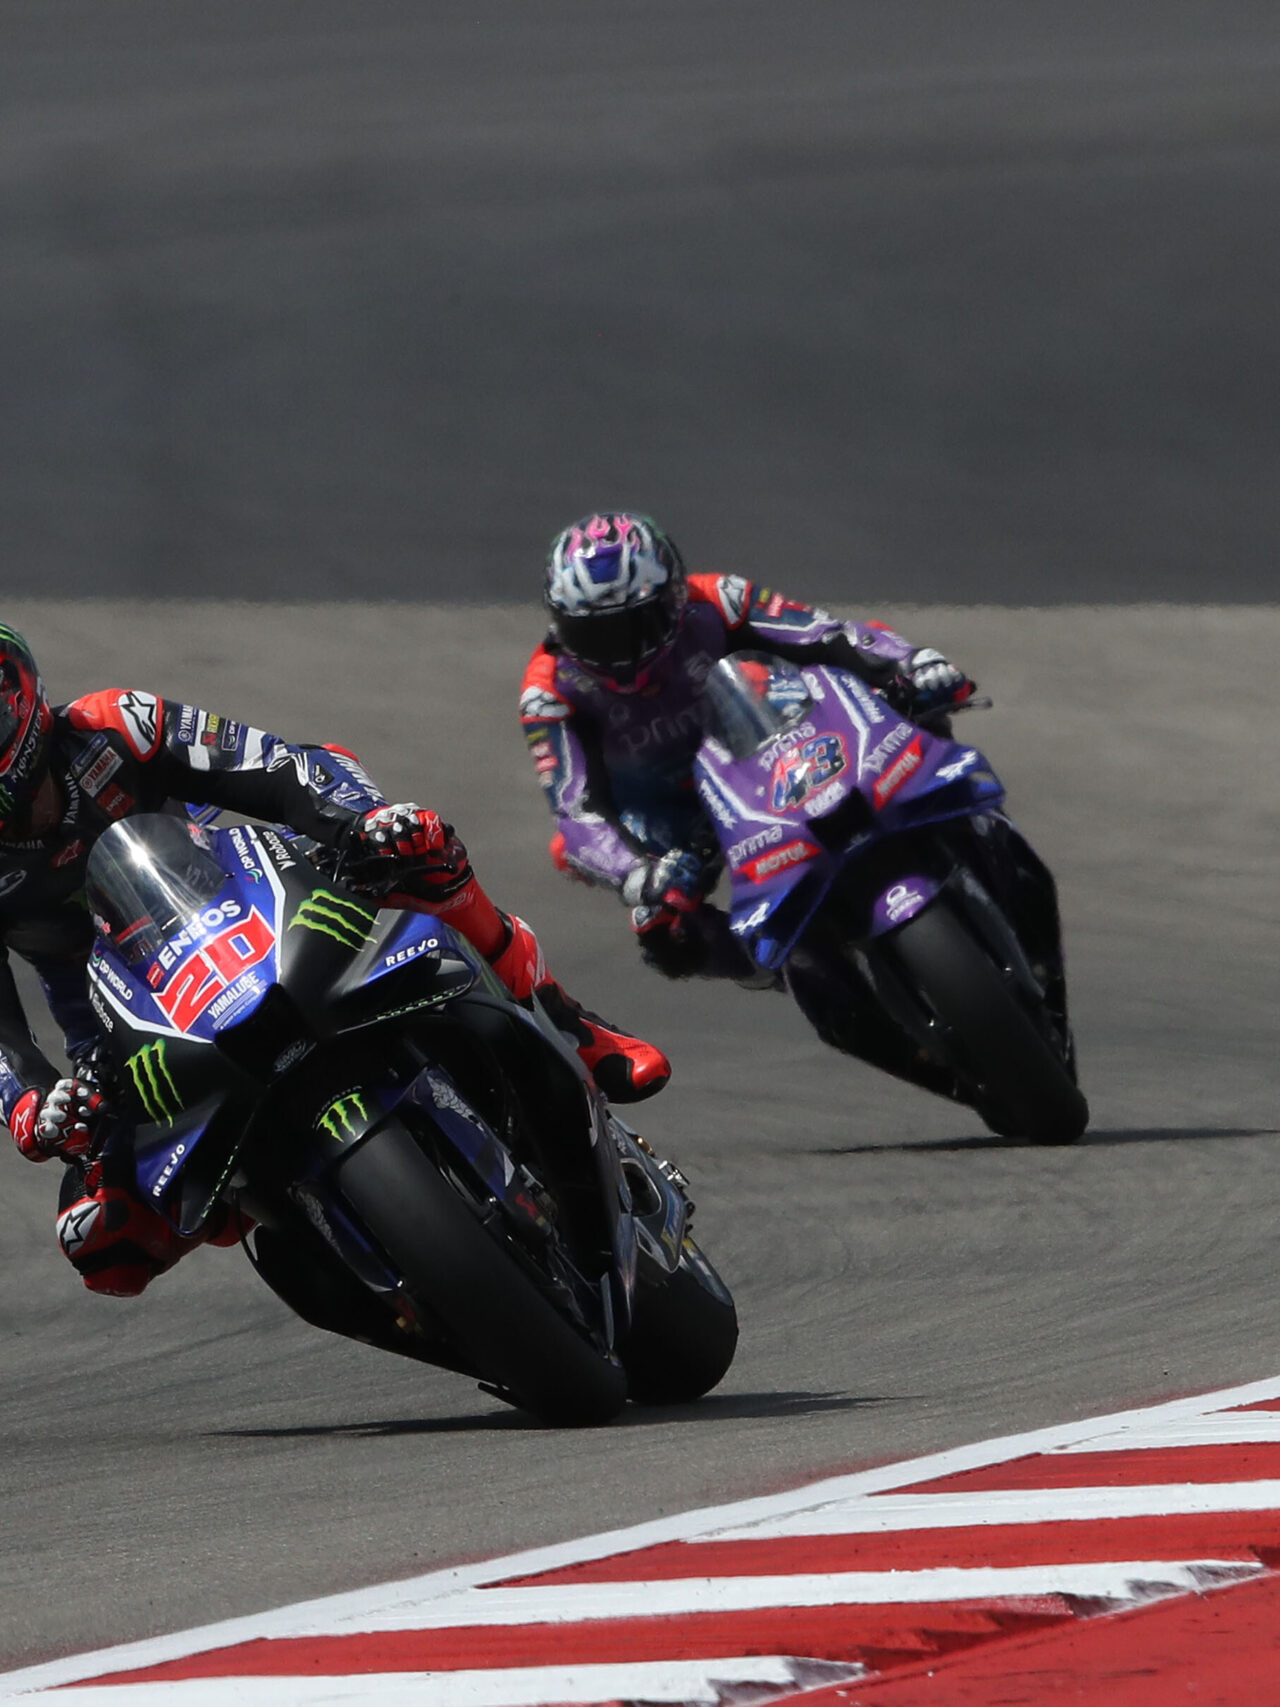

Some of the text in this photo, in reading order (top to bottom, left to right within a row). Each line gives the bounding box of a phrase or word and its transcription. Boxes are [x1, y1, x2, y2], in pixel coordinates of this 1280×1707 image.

[88, 749, 116, 779] YAMAHA
[771, 731, 851, 816] 43
[228, 827, 256, 870] DP WORLD
[755, 841, 810, 876] MOTUL
[158, 899, 242, 970] ENEOS
[385, 938, 439, 967] REEVO
[99, 959, 133, 1001] DP WORLD
[150, 904, 277, 1034] 20
[207, 970, 260, 1019] YAMALUBE
[152, 1143, 186, 1197] REEVO
